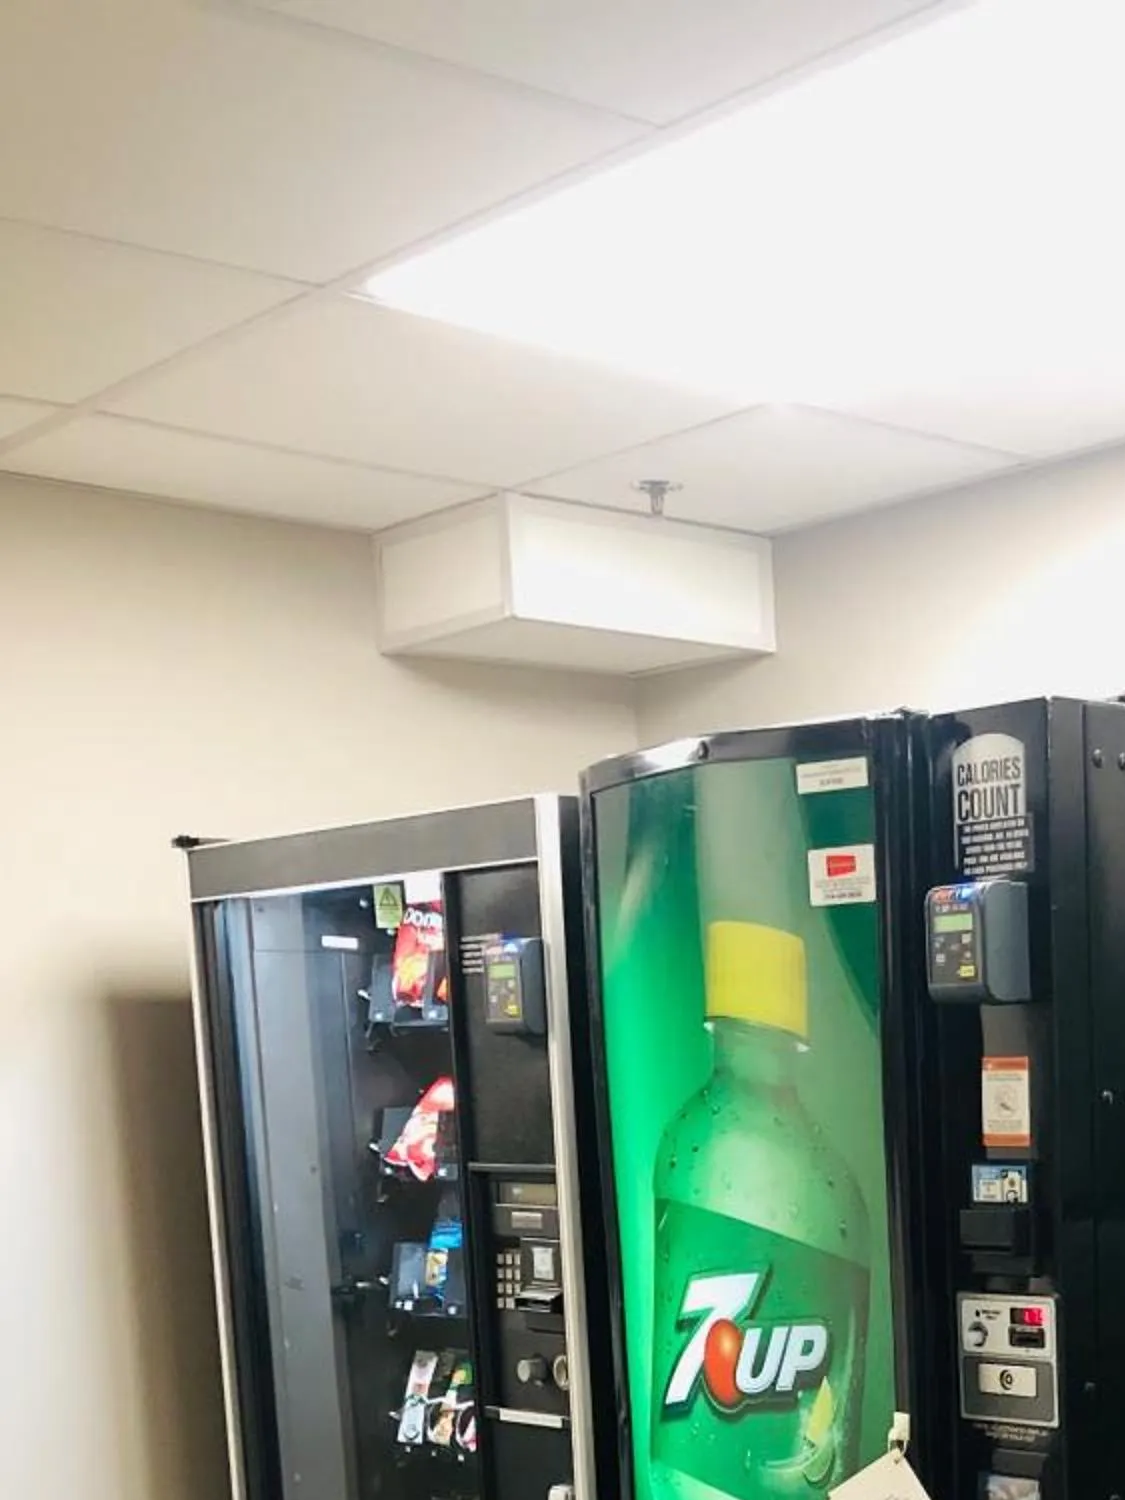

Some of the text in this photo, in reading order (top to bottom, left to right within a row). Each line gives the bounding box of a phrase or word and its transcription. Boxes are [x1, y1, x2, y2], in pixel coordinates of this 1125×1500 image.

[958, 756, 1021, 787] CALORIES
[958, 784, 1021, 822] COUNT
[665, 1272, 828, 1406] 7UP
